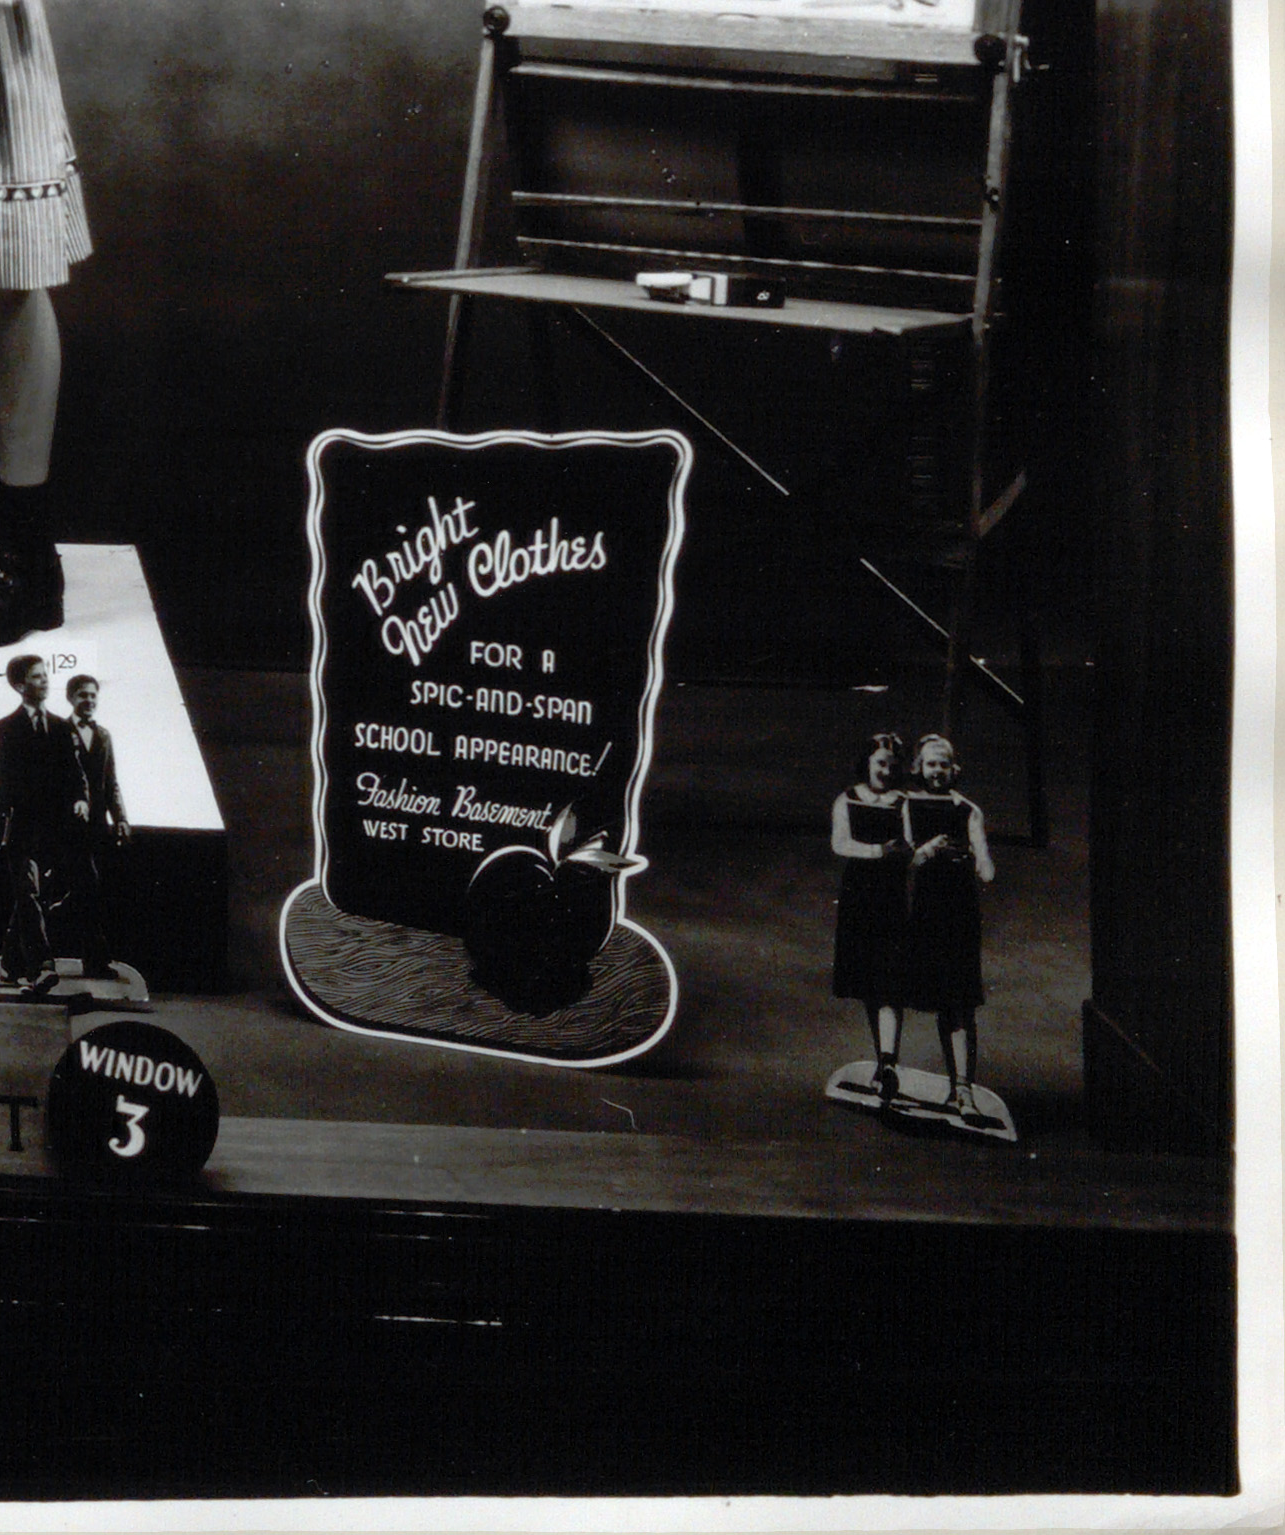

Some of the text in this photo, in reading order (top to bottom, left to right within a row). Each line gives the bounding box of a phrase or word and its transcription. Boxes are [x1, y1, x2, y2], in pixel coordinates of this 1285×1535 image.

[352, 496, 479, 616] Bright
[381, 517, 607, 666] New Clothes
[470, 640, 556, 674] FOR A
[409, 679, 593, 726] SPIC-AND-SPAN
[354, 722, 612, 776] SCHOOL APPEARANCE!
[356, 772, 442, 816] Fashion
[362, 819, 485, 852] WEST STORE
[80, 1040, 204, 1099] WINDOW
[108, 1094, 150, 1158] 3
